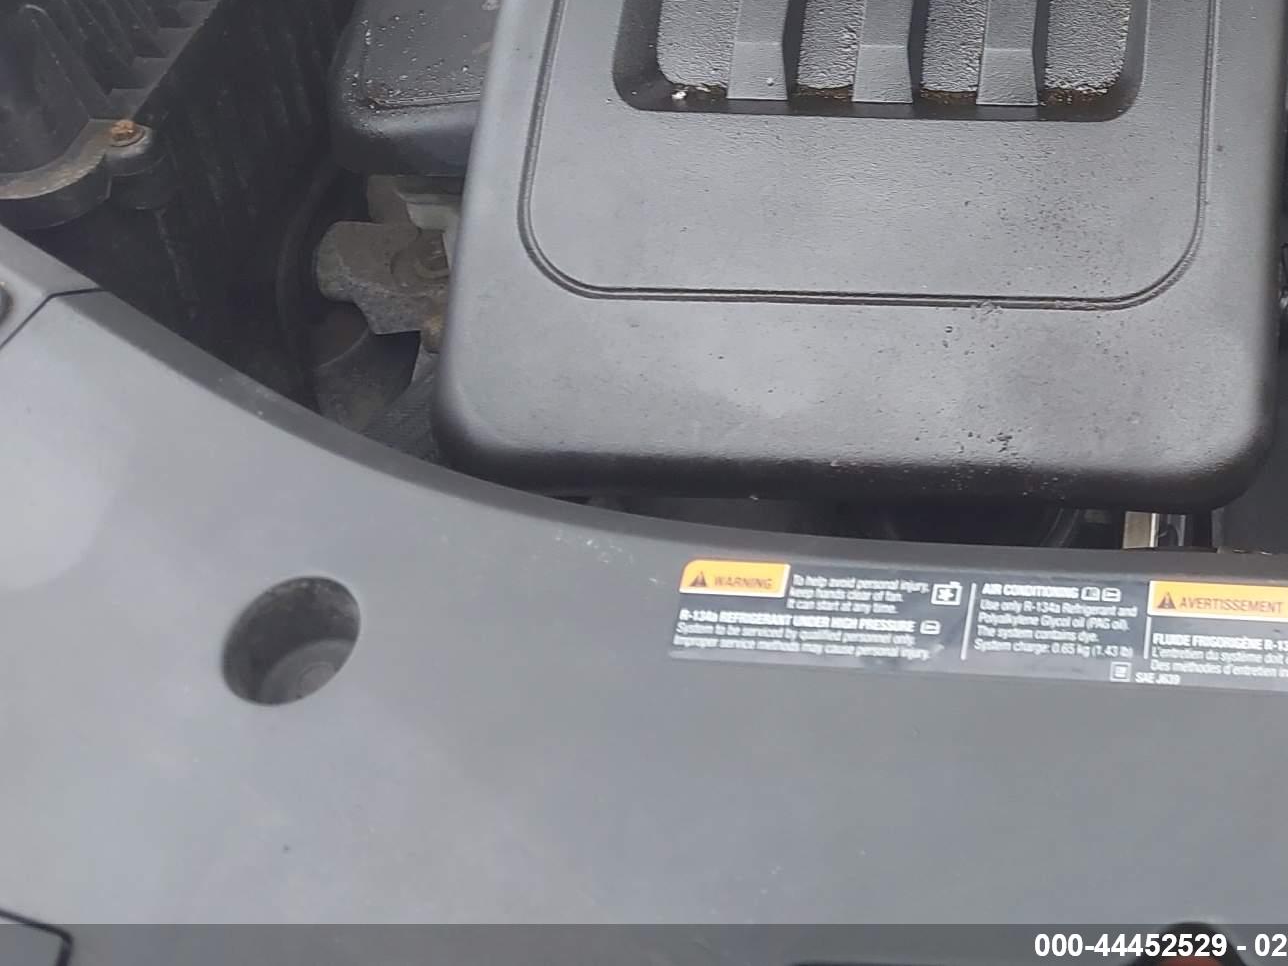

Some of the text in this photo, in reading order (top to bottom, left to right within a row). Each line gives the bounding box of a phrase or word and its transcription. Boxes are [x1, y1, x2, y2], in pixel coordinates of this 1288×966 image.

[714, 575, 773, 590] WARNING
[982, 583, 1079, 599] AIR CONDITIONING
[980, 598, 1138, 617] Use only R-134a Refrigerant and
[1179, 596, 1284, 614] AVERTISSEMENT
[679, 608, 917, 633] R-134a REFRIGERANT UNDER HIGH PRESSURE
[1040, 615, 1071, 629] Glycol
[676, 621, 714, 635] System
[742, 626, 784, 638] serviced
[997, 627, 1033, 640] system
[1034, 628, 1076, 641] contains
[974, 638, 1011, 652] System
[1151, 633, 1191, 647] FLUIDE
[719, 638, 756, 650] service
[756, 640, 800, 653] methods
[856, 645, 899, 658] personal
[1205, 650, 1219, 661] du
[1150, 659, 1171, 672] Des
[1135, 672, 1155, 684] SAE
